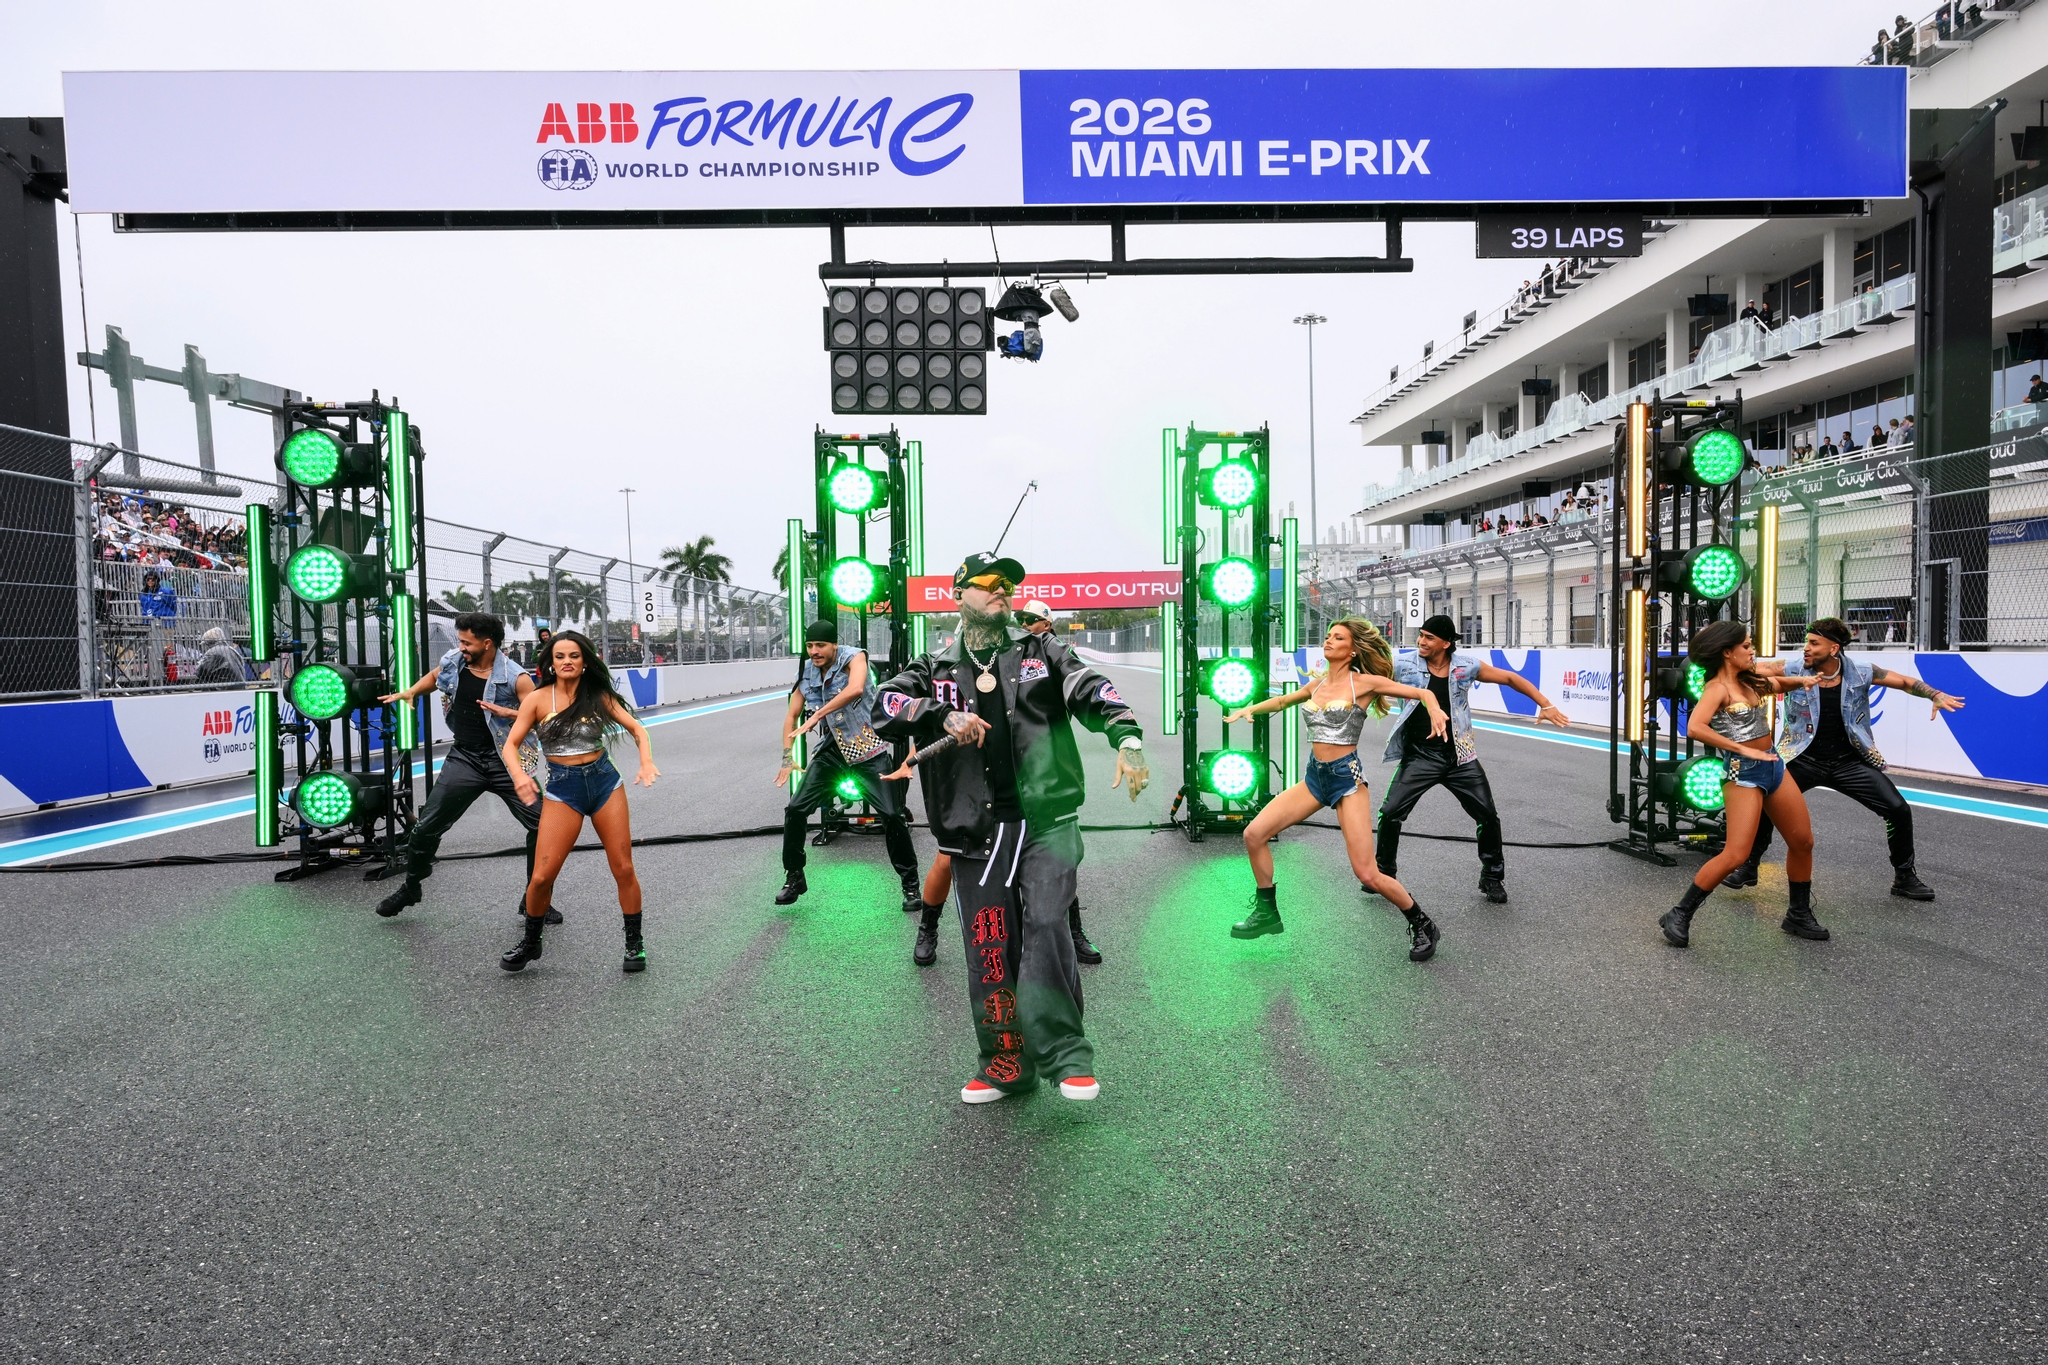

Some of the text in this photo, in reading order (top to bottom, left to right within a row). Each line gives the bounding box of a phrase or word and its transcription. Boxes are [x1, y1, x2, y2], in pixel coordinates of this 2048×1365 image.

[536, 103, 639, 143] ABB
[646, 96, 893, 150] FORMULA
[1069, 98, 1212, 136] 2026
[1071, 138, 1432, 177] MIAMI E-PRIX
[605, 162, 689, 179] WORLD
[699, 161, 880, 178] CHAMPIONSHIP
[1511, 227, 1625, 249] 39 LAPS
[1837, 462, 1875, 488] Google
[1071, 583, 1101, 598] TO
[1105, 582, 1183, 598] OUTRU
[1562, 670, 1577, 686] ABB
[203, 710, 233, 737] ABB
[223, 743, 248, 755] WORLD
